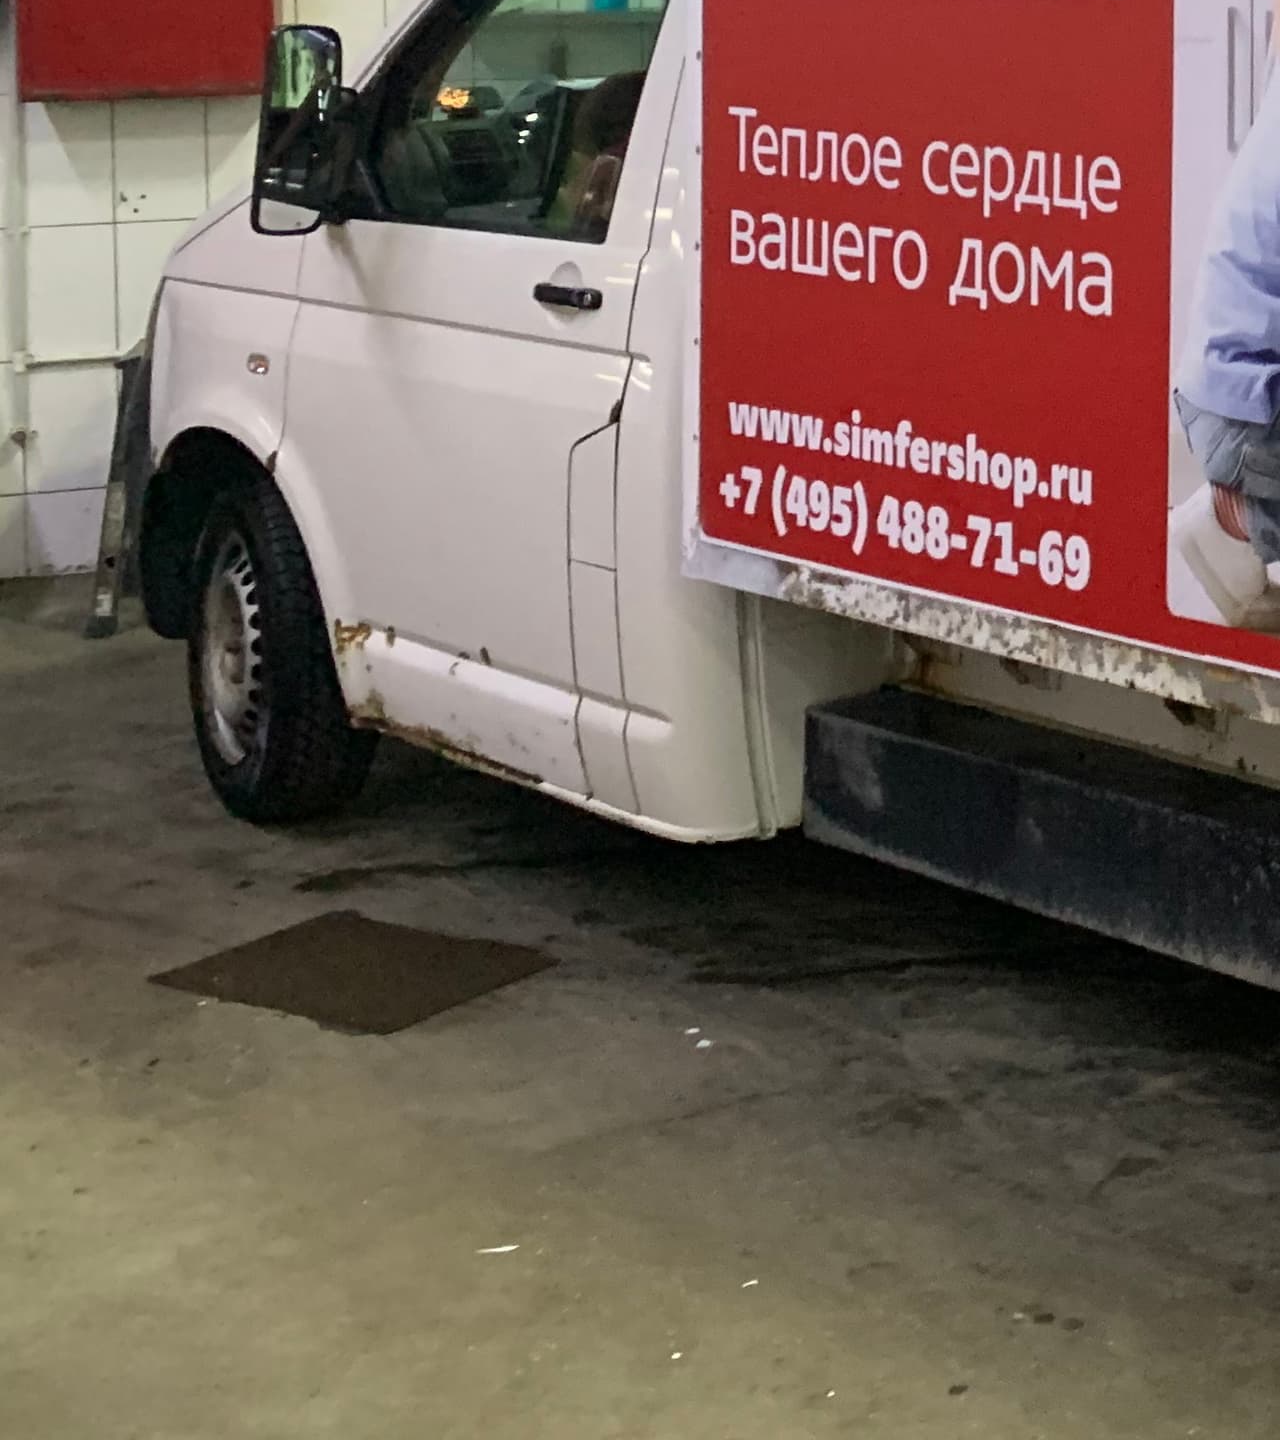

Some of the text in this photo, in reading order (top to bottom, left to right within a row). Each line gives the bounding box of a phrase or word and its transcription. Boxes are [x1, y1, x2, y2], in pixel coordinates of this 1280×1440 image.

[728, 106, 1122, 220] Теплое сердце
[729, 208, 1114, 317] вашего дома
[727, 400, 1094, 507] www.simfershop.ru
[718, 464, 1092, 592] +7 (495) 488-71-69
